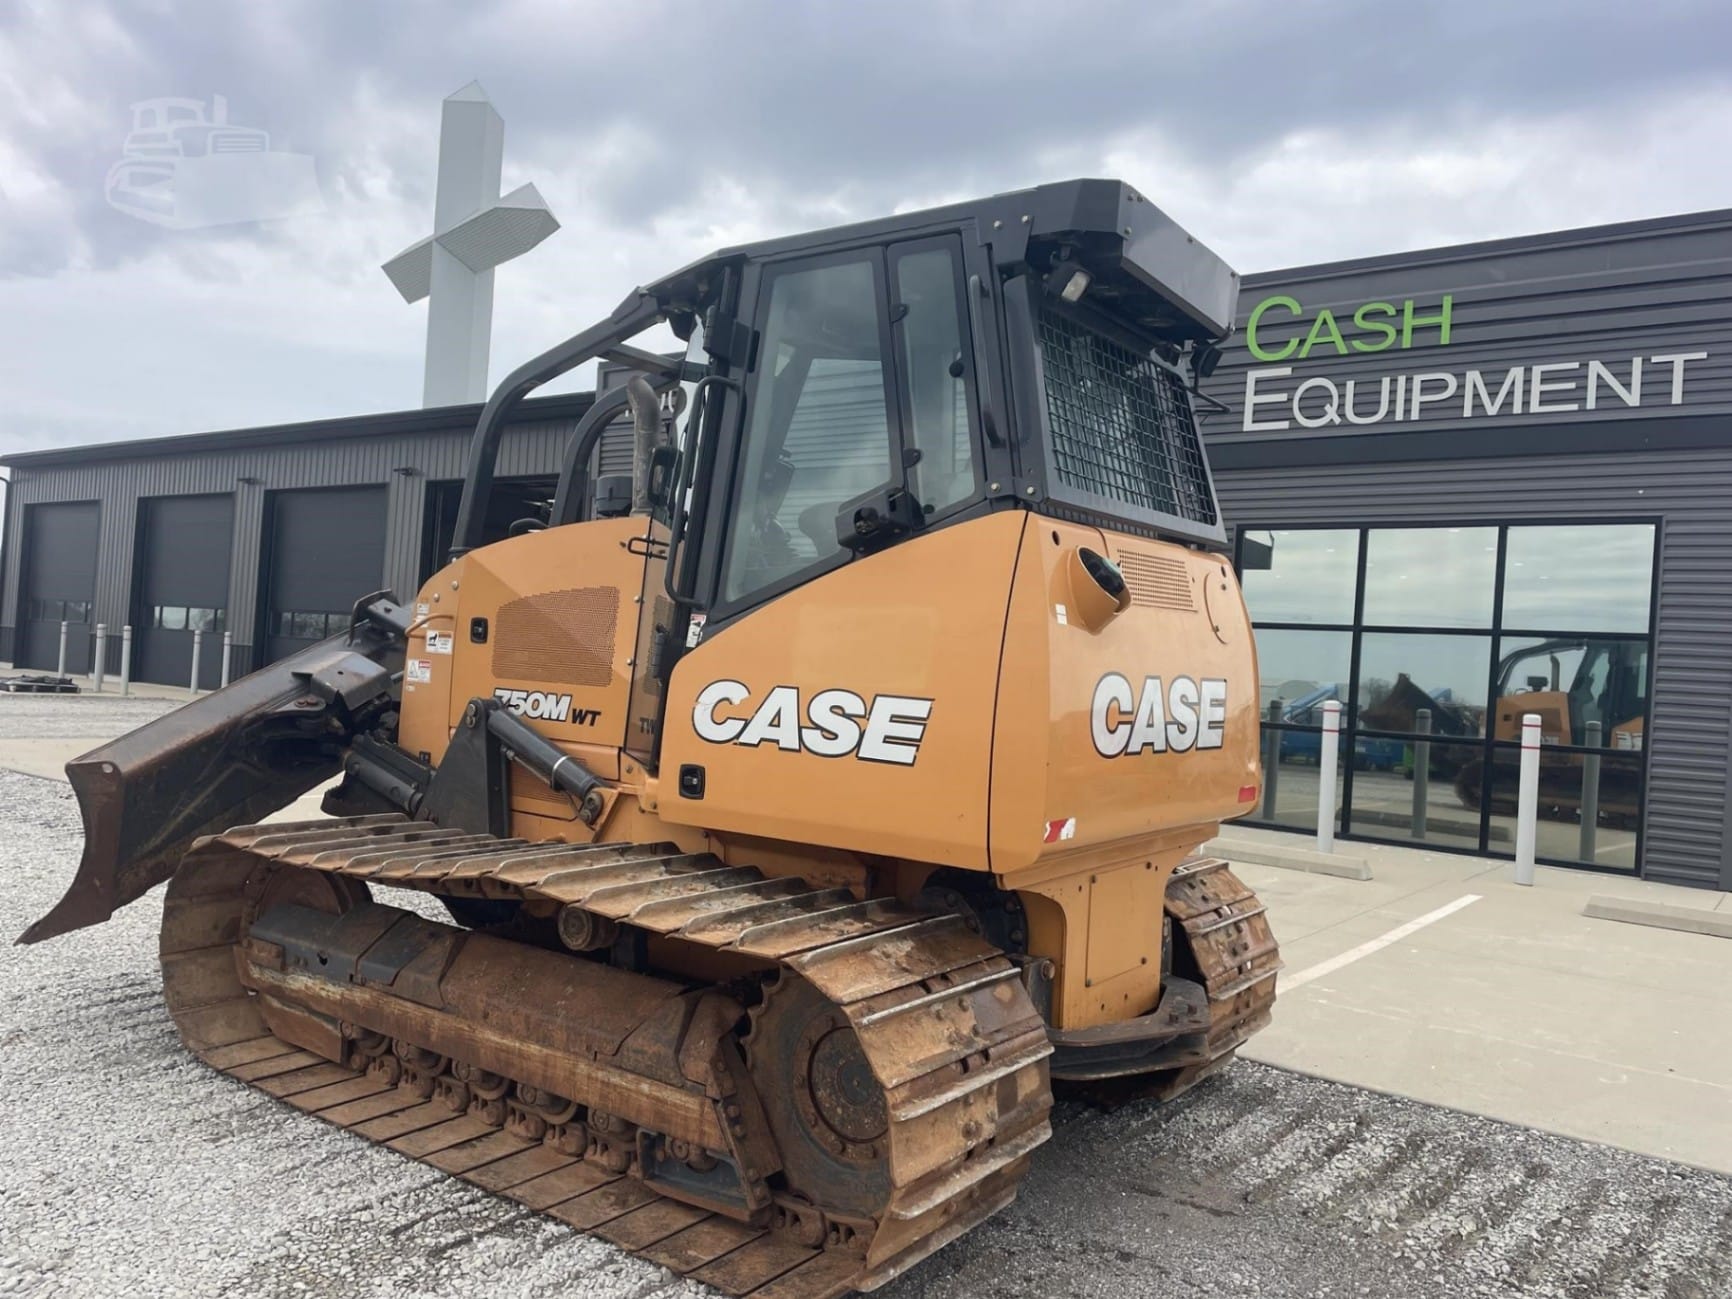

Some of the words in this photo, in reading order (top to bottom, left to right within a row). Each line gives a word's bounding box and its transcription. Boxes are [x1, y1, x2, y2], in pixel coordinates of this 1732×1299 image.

[493, 687, 572, 722] 750M
[572, 709, 602, 727] WT
[692, 679, 935, 766] CASE
[1090, 672, 1227, 758] CASE
